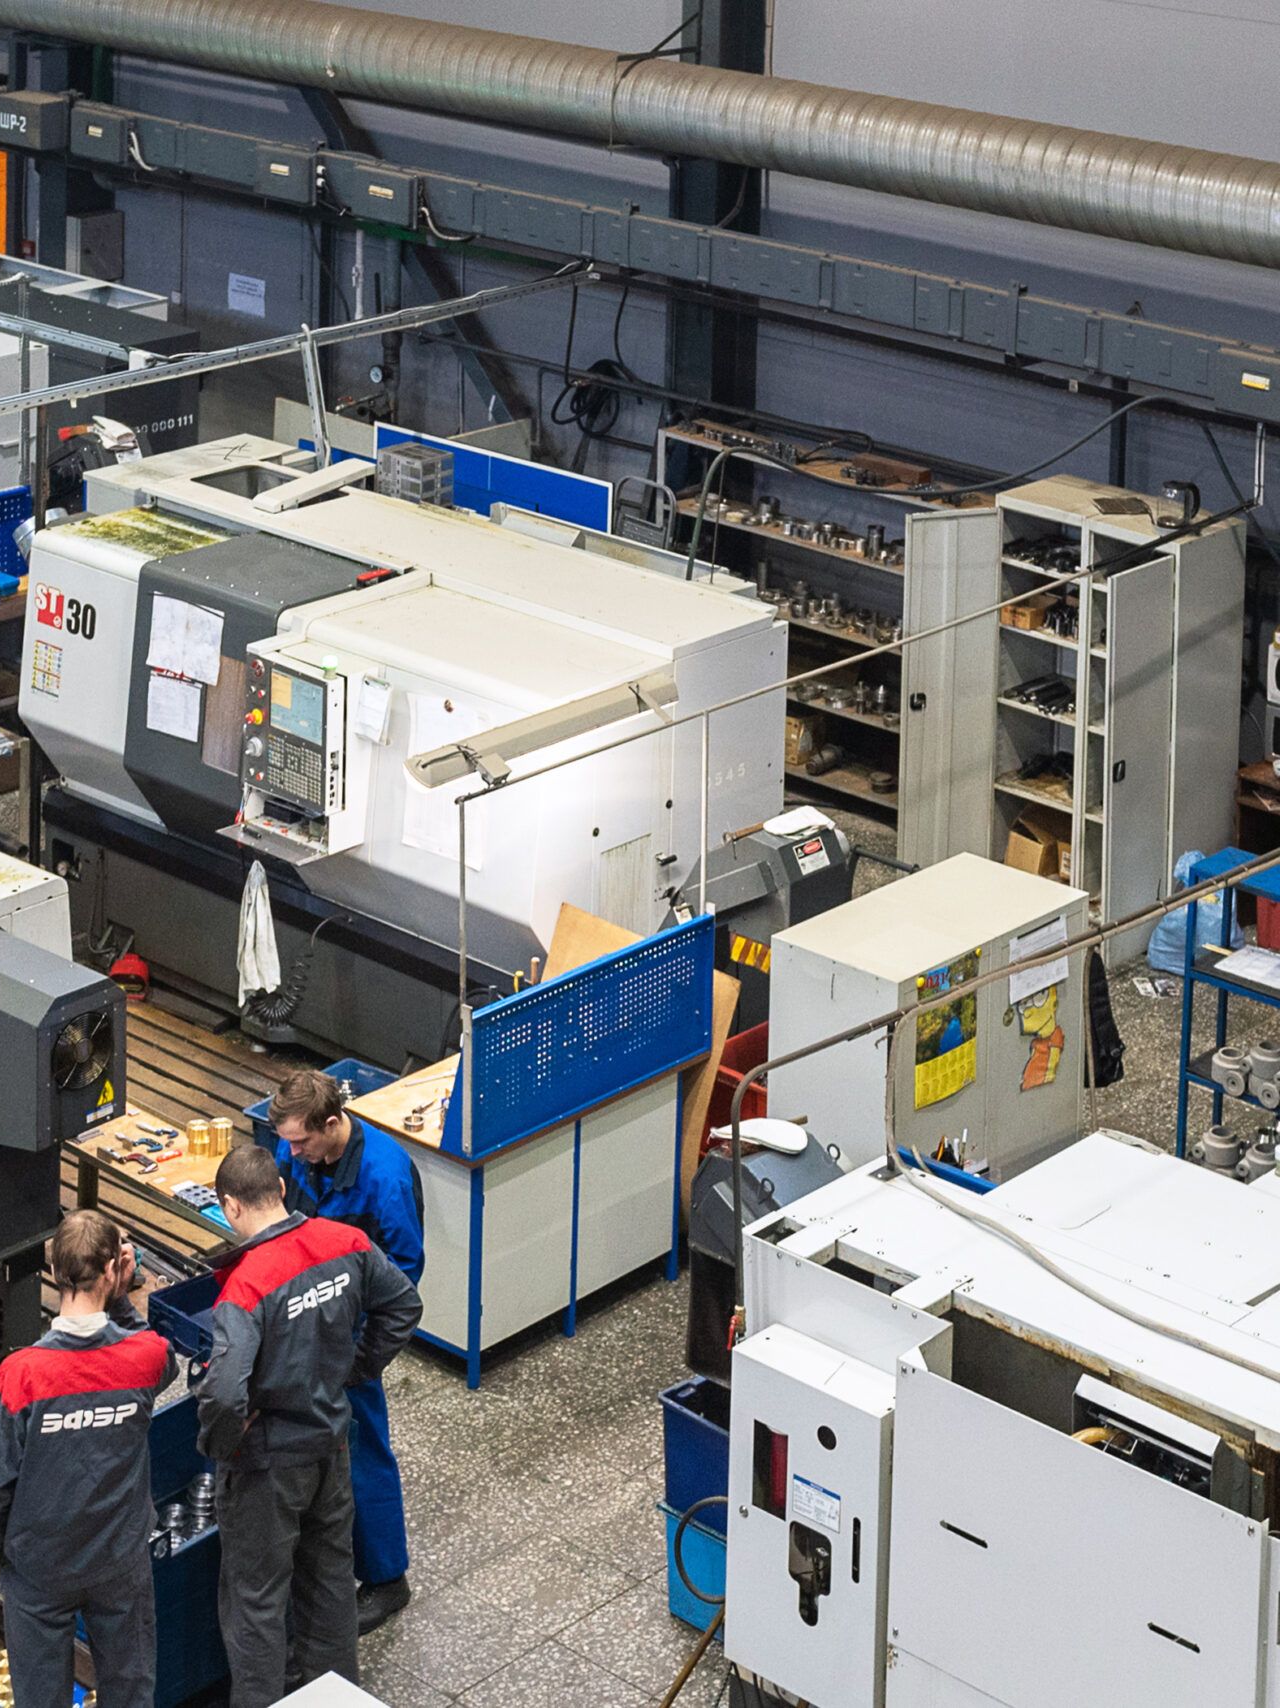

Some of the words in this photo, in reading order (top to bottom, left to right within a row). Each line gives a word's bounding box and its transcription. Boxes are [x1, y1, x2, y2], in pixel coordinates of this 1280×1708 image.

[151, 418, 175, 433] 000
[177, 414, 193, 428] 111
[34, 583, 62, 614] ST
[66, 598, 96, 640] 30
[287, 1272, 350, 1320] ЭФЭР
[40, 1402, 138, 1434] ЭФЭР
